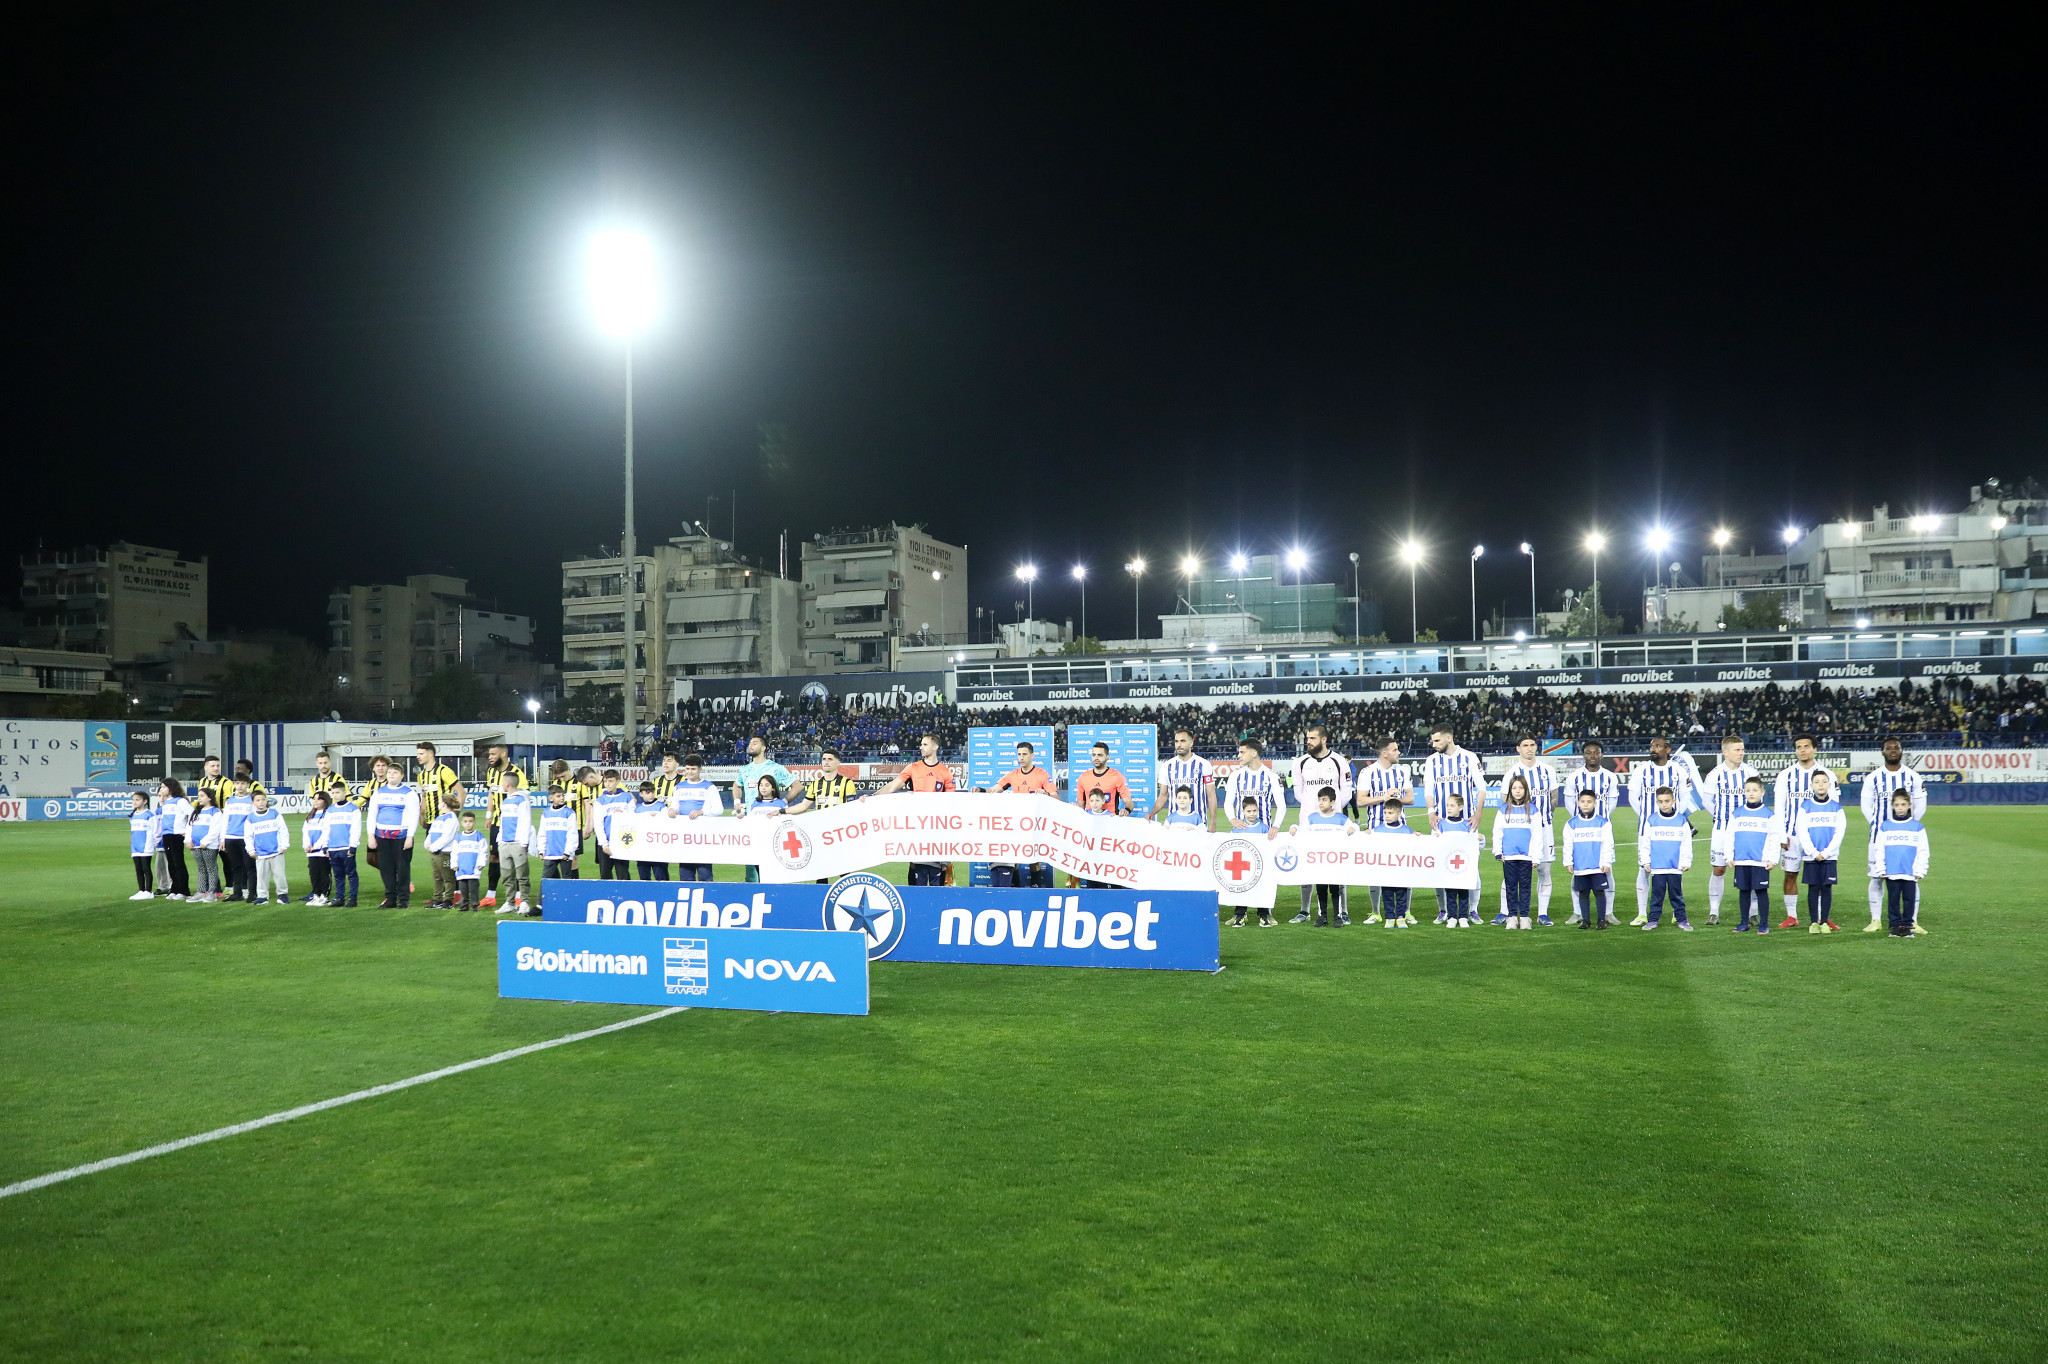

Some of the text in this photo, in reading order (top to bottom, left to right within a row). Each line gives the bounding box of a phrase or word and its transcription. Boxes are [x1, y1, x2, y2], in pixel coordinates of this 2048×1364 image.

[1717, 666, 1772, 680] novibet
[1819, 664, 1875, 677] novibet
[1923, 661, 1981, 675] novibet
[1465, 674, 1510, 686] novibet
[1537, 672, 1582, 684] novibet
[1622, 669, 1674, 683] novibet
[1209, 682, 1254, 695] novibet
[1295, 680, 1342, 692] novibet
[1381, 677, 1429, 690] novibet
[845, 684, 937, 710] novibet
[973, 690, 1014, 701] novibet
[1048, 687, 1090, 699] novibet
[1129, 685, 1172, 697] novibet
[131, 732, 160, 742] capelli
[175, 738, 203, 748] capelli
[1171, 777, 1198, 785] novibet
[1306, 778, 1333, 786] novibet
[1436, 775, 1467, 783] novibet
[1240, 788, 1269, 797] novibet
[1790, 790, 1814, 799] novib
[281, 795, 313, 807] ΛΟΥΚ
[646, 832, 750, 846] STOP BULLYING
[821, 821, 869, 846] STOP
[871, 815, 963, 834] BULLYING
[979, 816, 1015, 831] ΠΕΣ
[1019, 816, 1047, 832] ΟΧΙ
[1051, 820, 1096, 850] ΣΤΟΝ
[885, 842, 1139, 883] ΕΛΛΗΝΙΚΟΣ ΕΡΥΘΡΟΣ ΣΤΑΥΡΟΣ
[1306, 851, 1435, 868] STOP BULLYING
[829, 877, 900, 911] ΑΤΡΟΜΗΤΟΣ ΑΘΗΝΩΝ
[586, 887, 772, 928] novibet
[938, 895, 1160, 951] novibet
[516, 946, 648, 975] Stoiximan
[724, 958, 836, 982] NOVA
